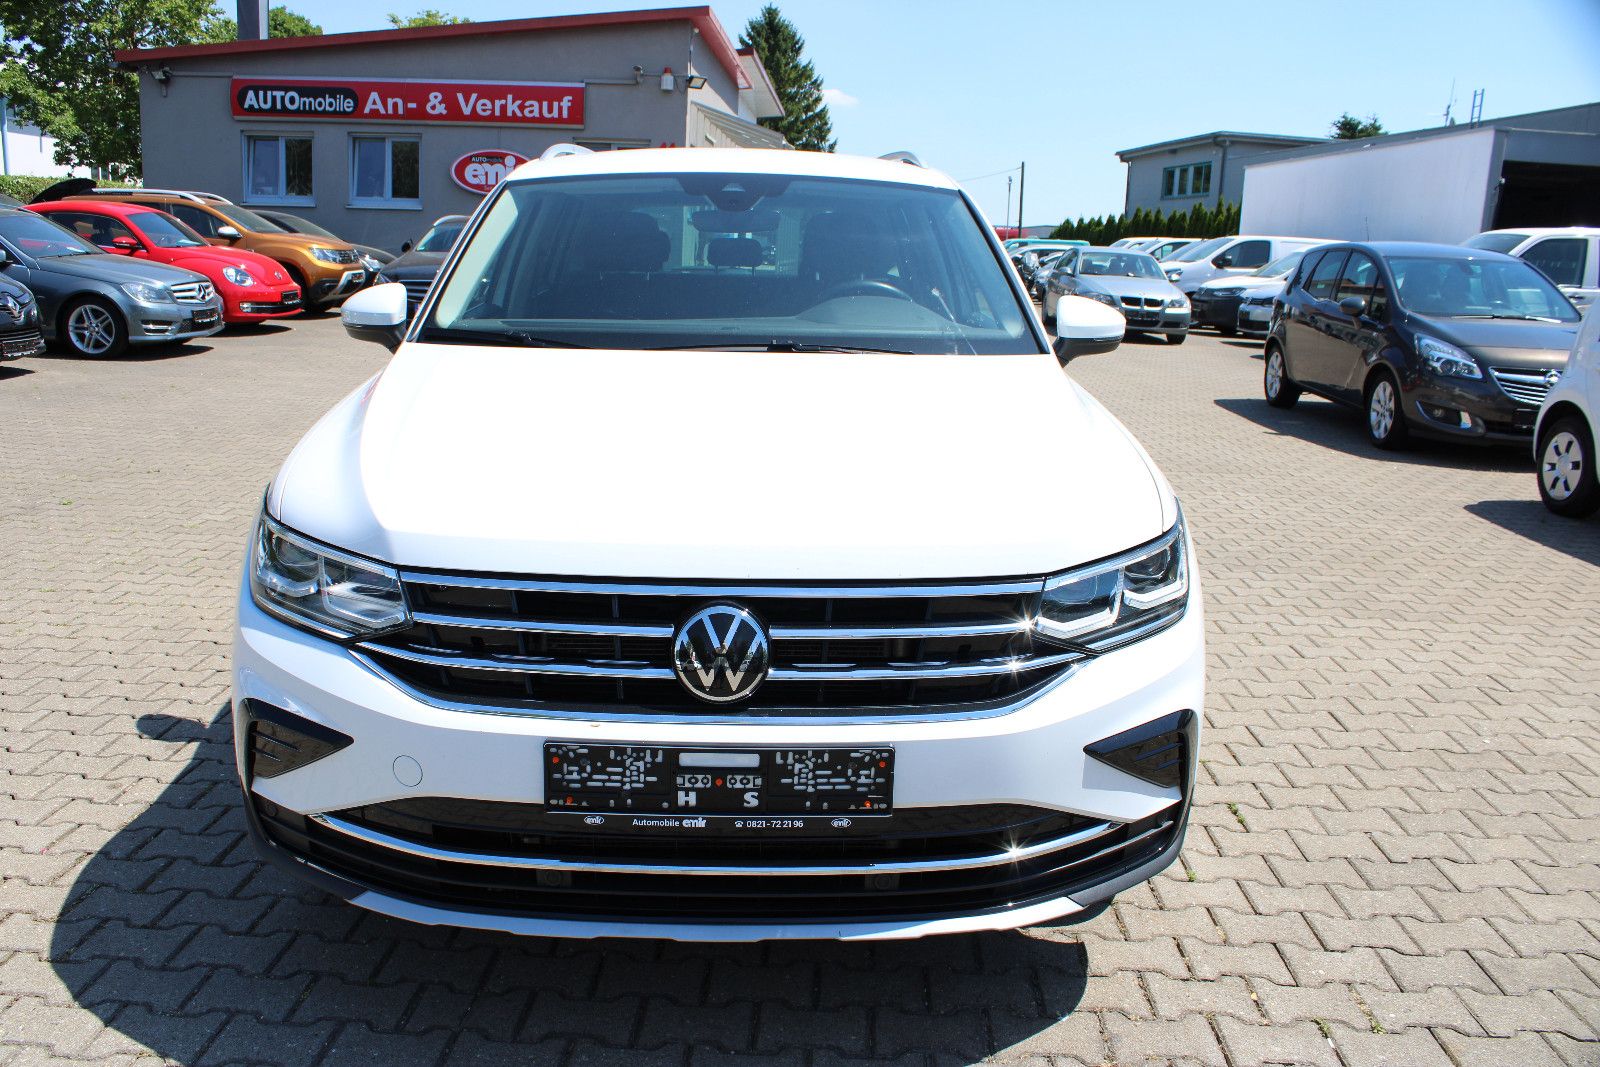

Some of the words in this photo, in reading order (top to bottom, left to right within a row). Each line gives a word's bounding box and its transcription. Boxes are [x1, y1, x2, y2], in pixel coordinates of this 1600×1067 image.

[243, 89, 354, 113] AUTOmobile
[363, 91, 417, 116] An-
[425, 91, 447, 115] &
[456, 92, 573, 119] Verkauf
[464, 155, 516, 185] emi
[632, 818, 680, 827] Automobile
[682, 816, 707, 828] emir
